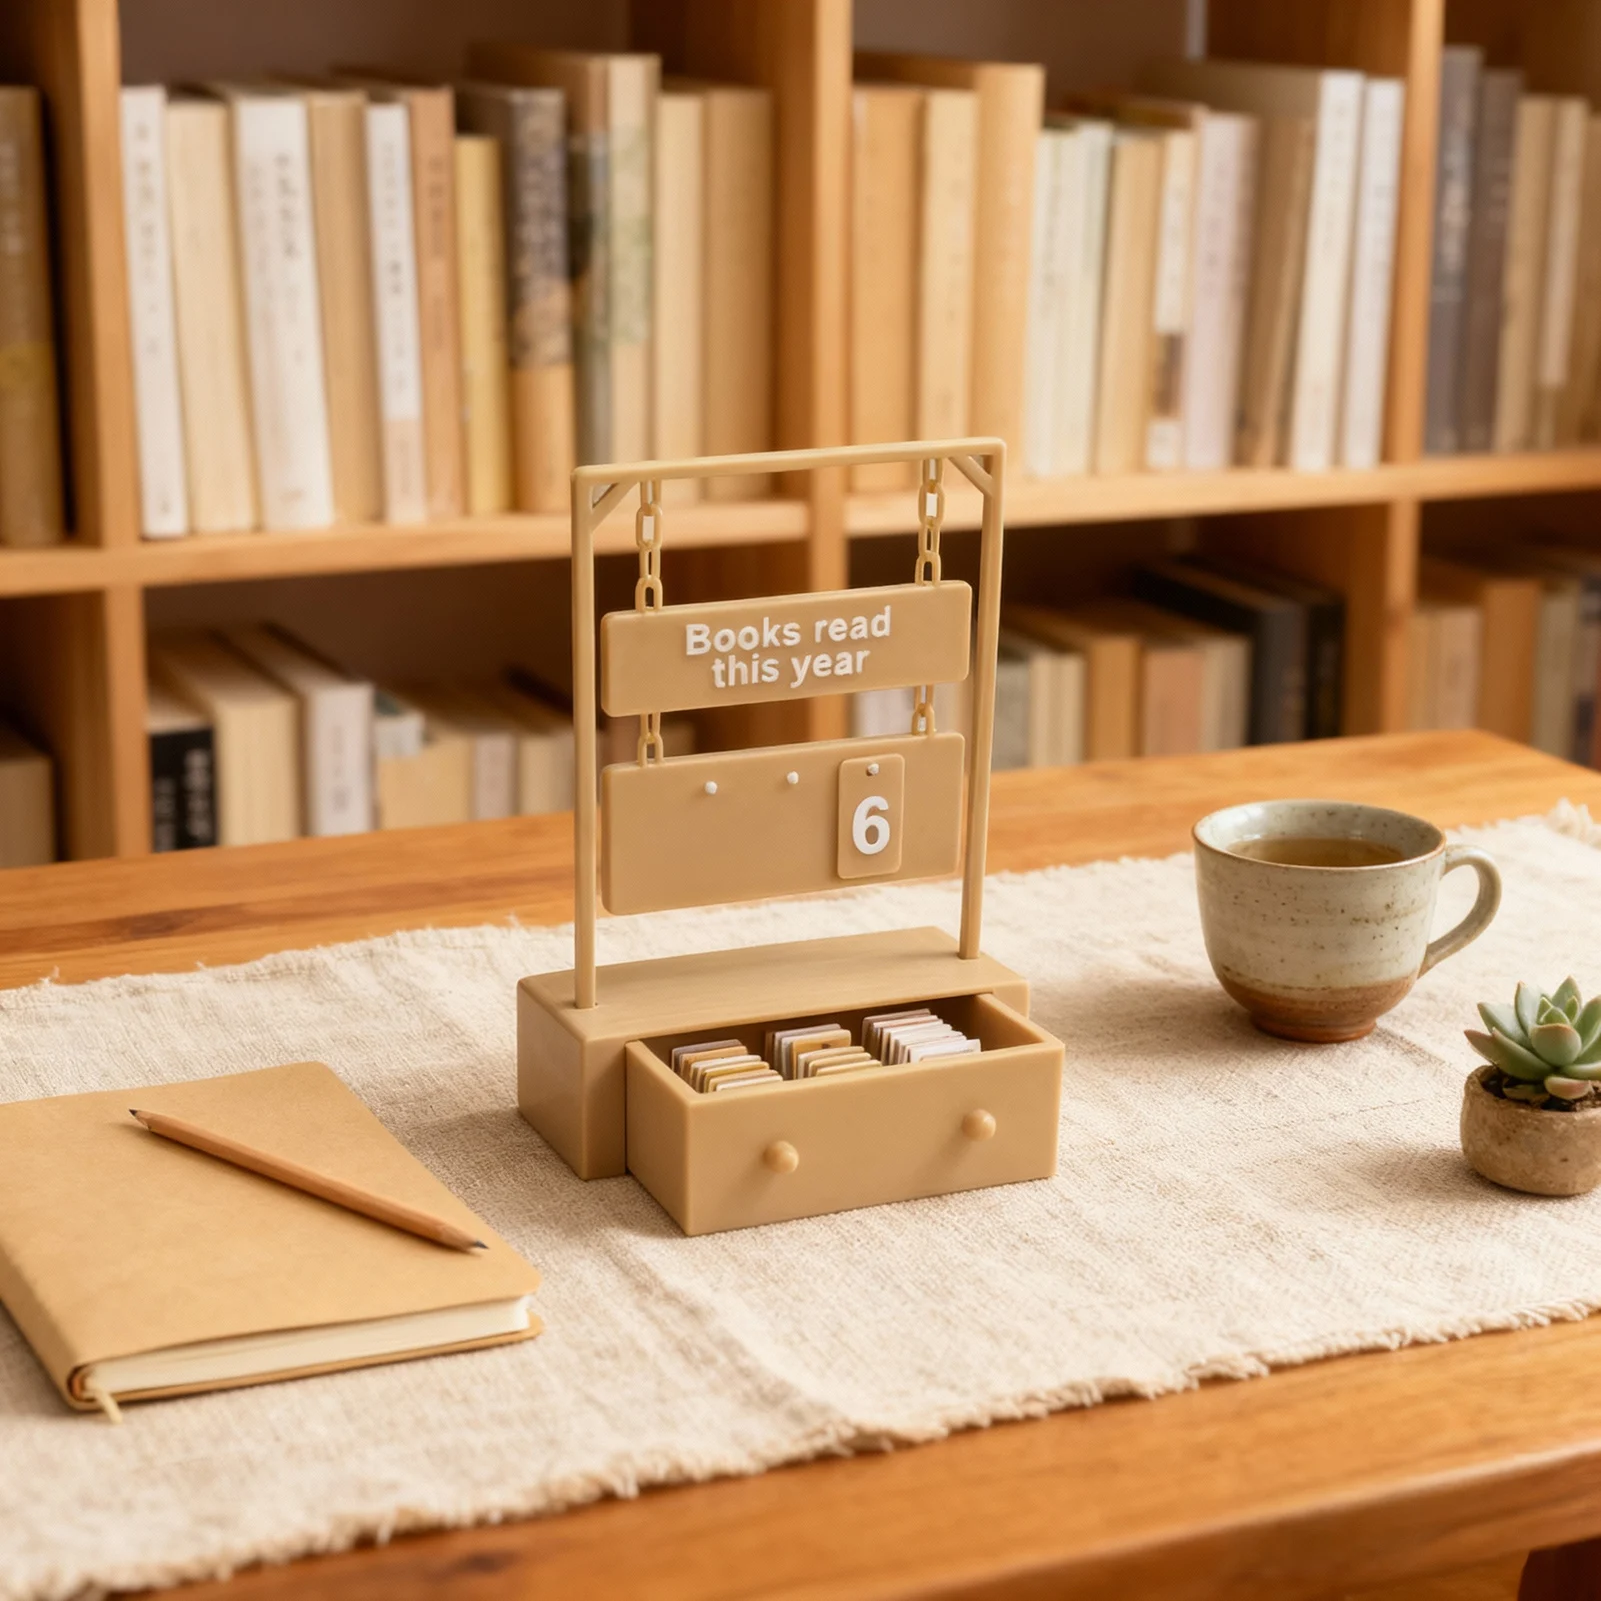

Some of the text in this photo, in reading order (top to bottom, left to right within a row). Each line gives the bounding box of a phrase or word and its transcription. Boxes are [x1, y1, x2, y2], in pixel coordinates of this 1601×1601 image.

[685, 606, 891, 656] Books read
[712, 650, 869, 688] this year
[852, 796, 890, 855] 6
